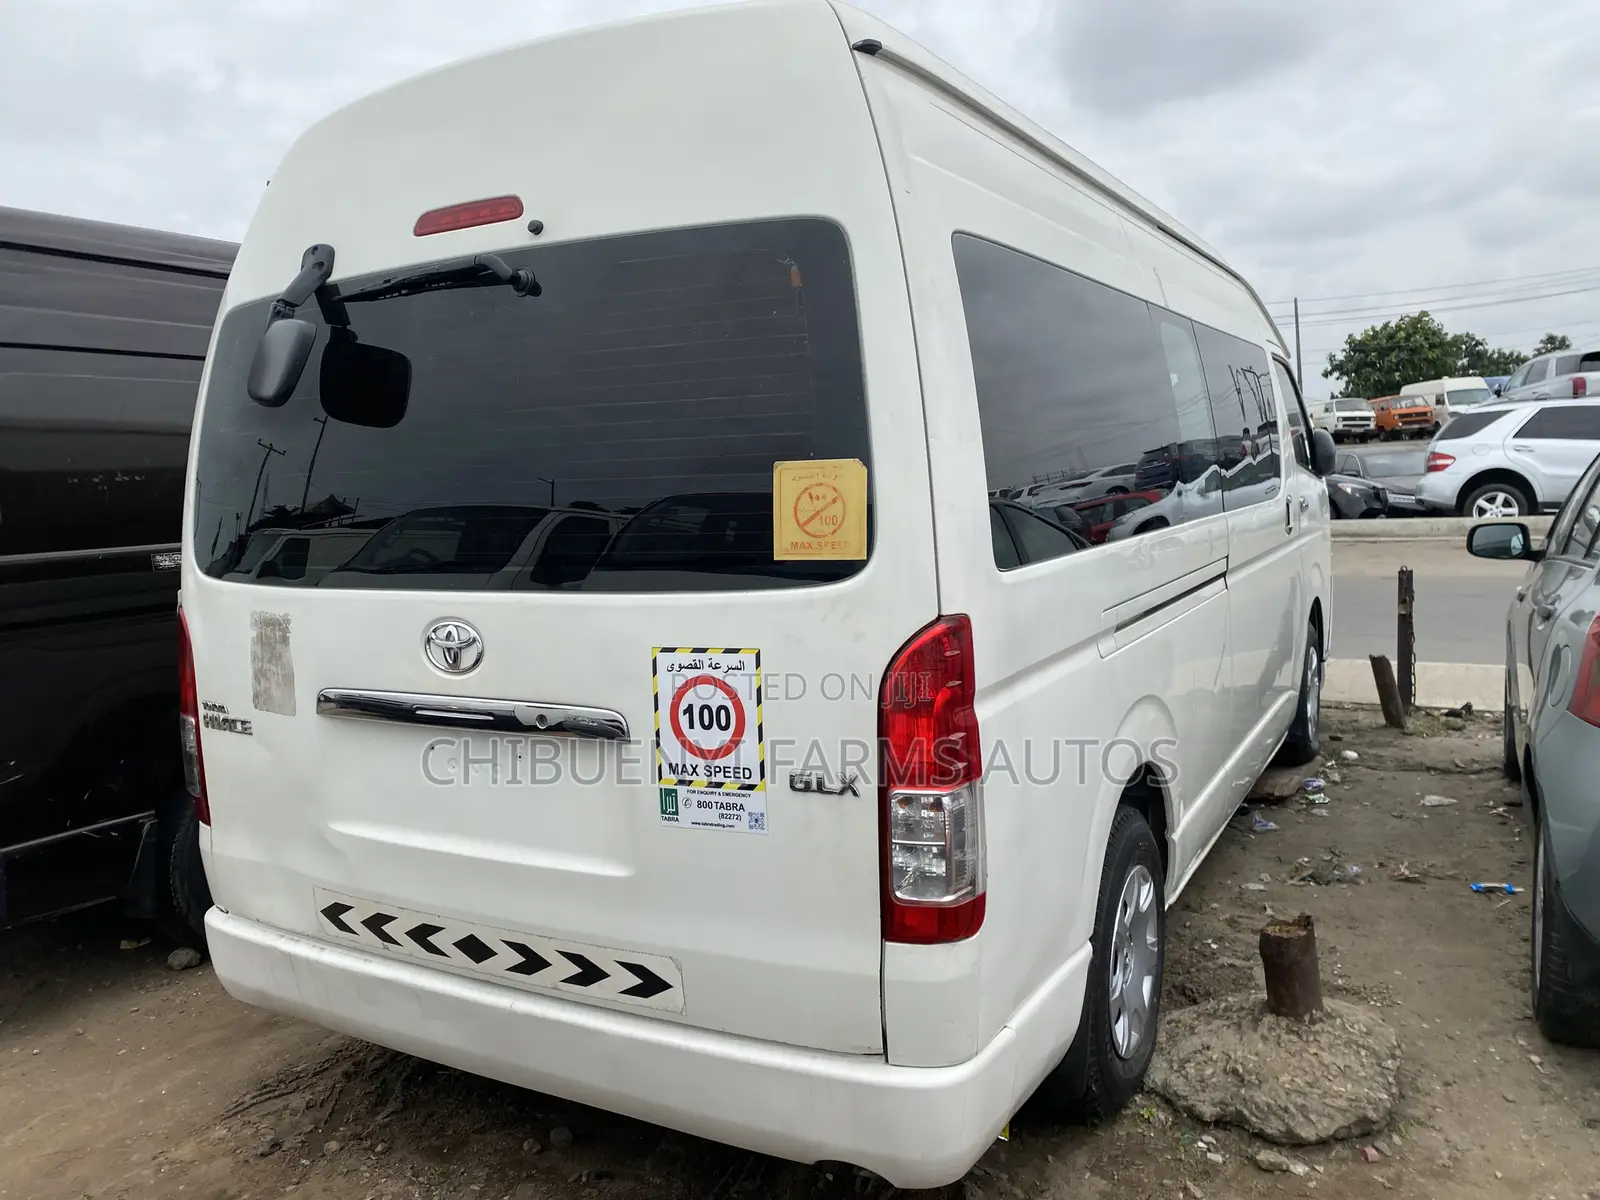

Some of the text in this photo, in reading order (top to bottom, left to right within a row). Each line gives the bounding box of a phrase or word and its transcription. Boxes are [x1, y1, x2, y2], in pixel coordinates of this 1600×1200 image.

[666, 657, 745, 674] السرعة القصوى
[682, 703, 731, 731] 100
[668, 762, 753, 780] MAX SPEED
[788, 770, 861, 797] GLX
[696, 800, 746, 812] 800 TABRA
[660, 815, 680, 823] TABRA
[718, 812, 742, 822] (82272)
